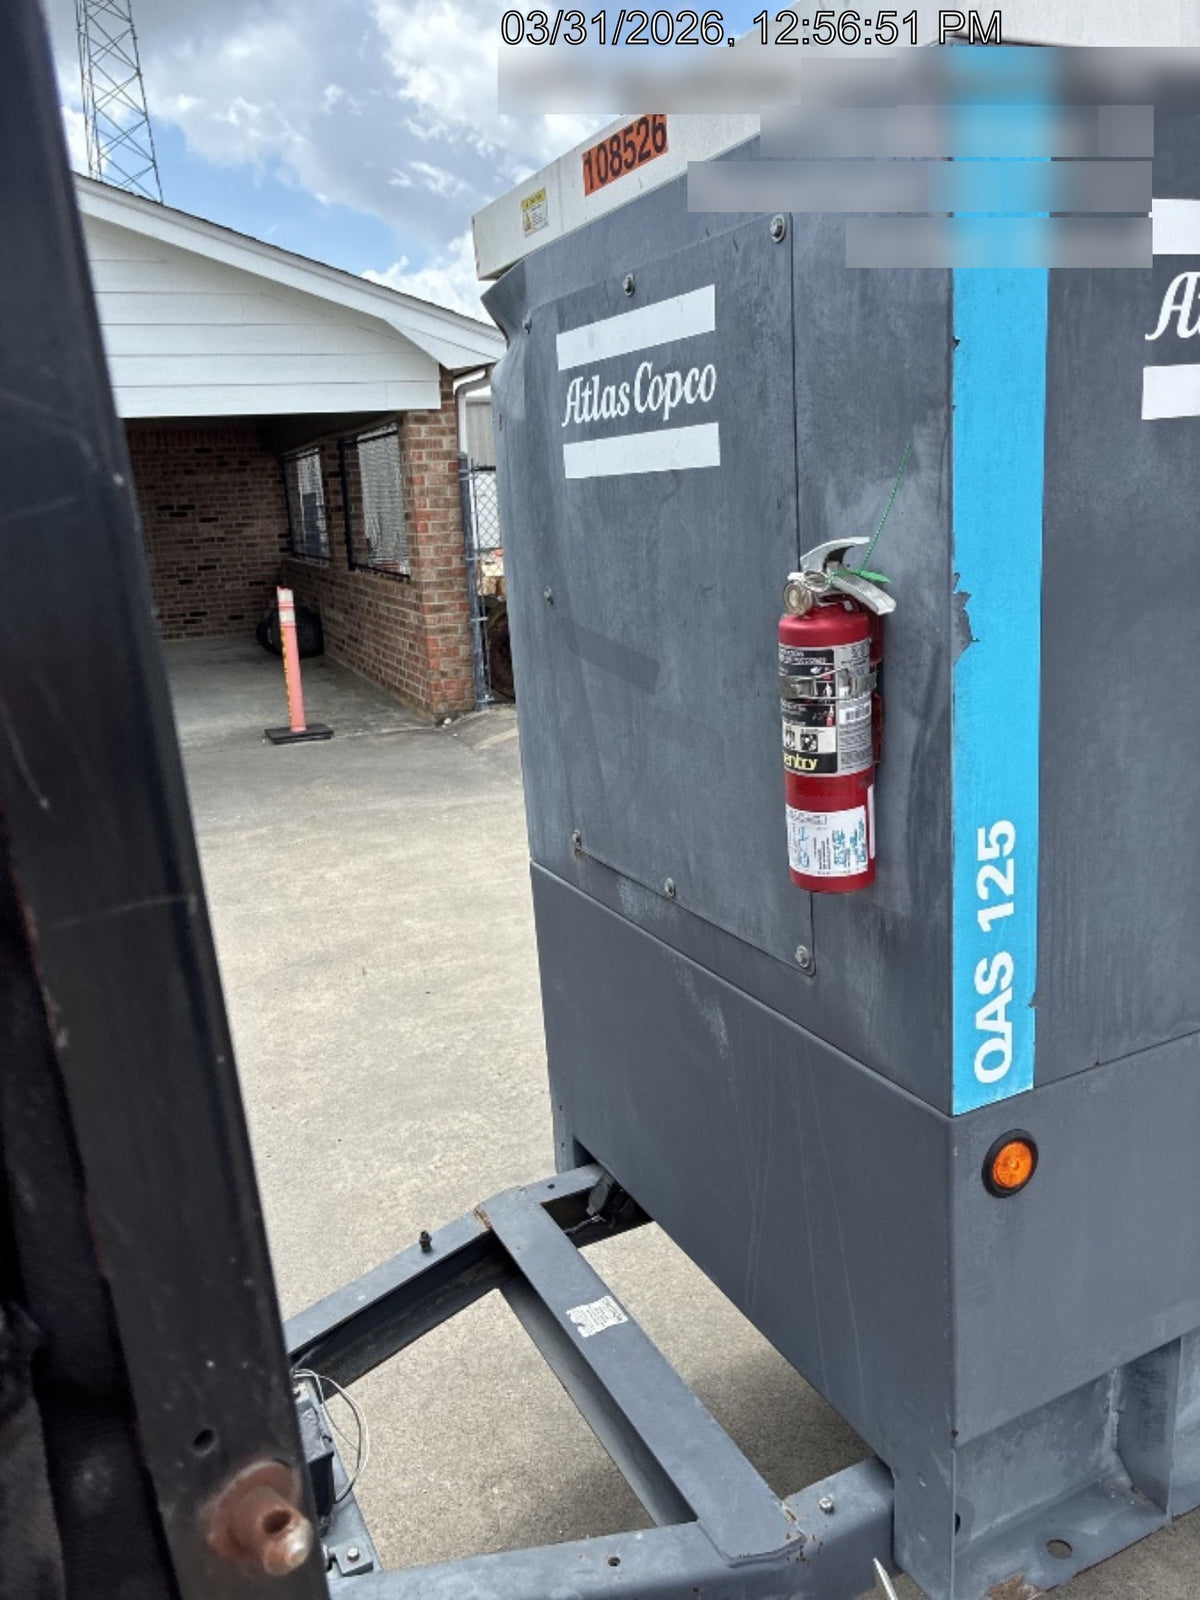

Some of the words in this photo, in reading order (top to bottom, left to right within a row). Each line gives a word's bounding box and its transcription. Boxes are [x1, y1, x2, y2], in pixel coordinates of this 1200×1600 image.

[583, 114, 667, 190] 108526
[561, 374, 630, 427] Atlas
[634, 361, 717, 422] Copco
[976, 820, 1016, 932] 125
